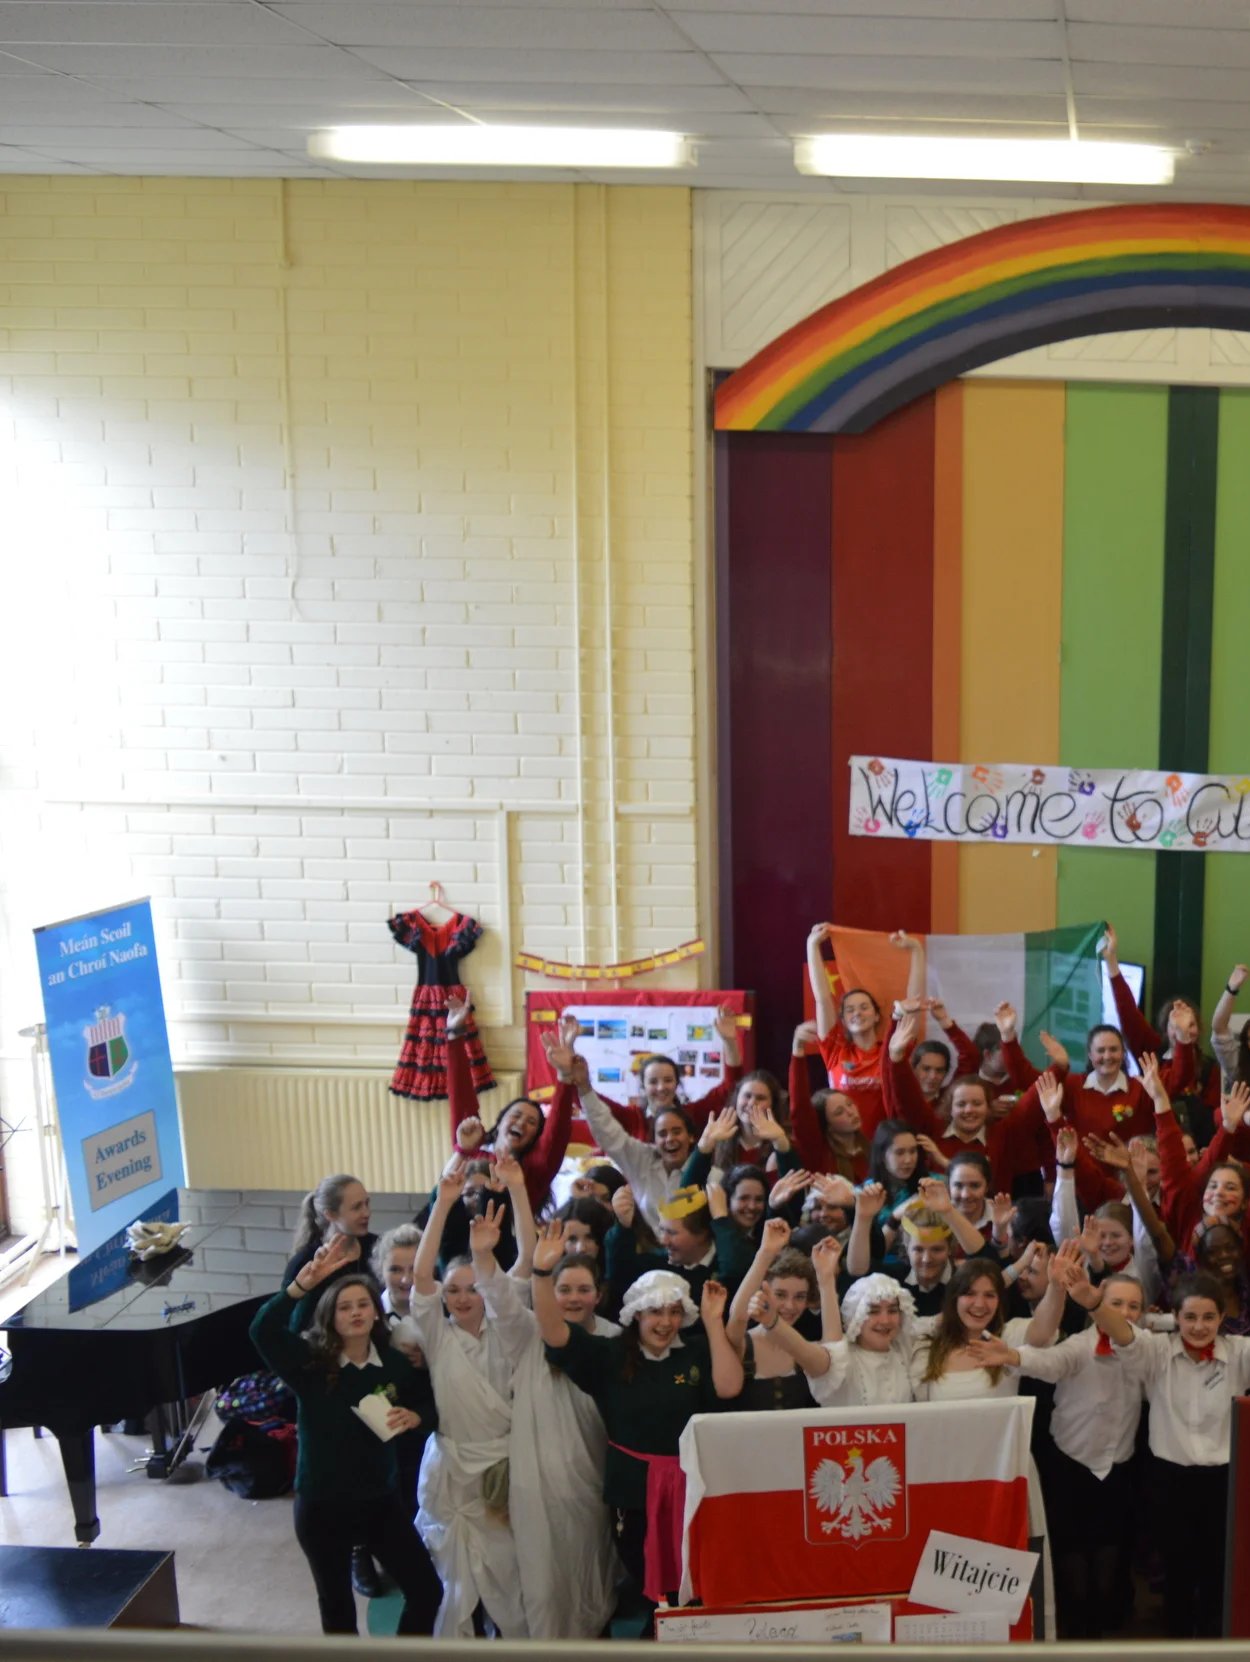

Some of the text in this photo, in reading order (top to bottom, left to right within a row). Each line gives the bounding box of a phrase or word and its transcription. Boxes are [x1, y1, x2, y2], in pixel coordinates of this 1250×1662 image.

[859, 767, 1082, 839] Welcome
[1101, 775, 1160, 843] to
[58, 921, 132, 958] Meán Scoil
[47, 941, 149, 986] an Chroí Naofa
[95, 1129, 147, 1164] Awards
[96, 1155, 153, 1192] Evening
[812, 1429, 898, 1446] POLSKA
[933, 1549, 1020, 1595] Witajcie
